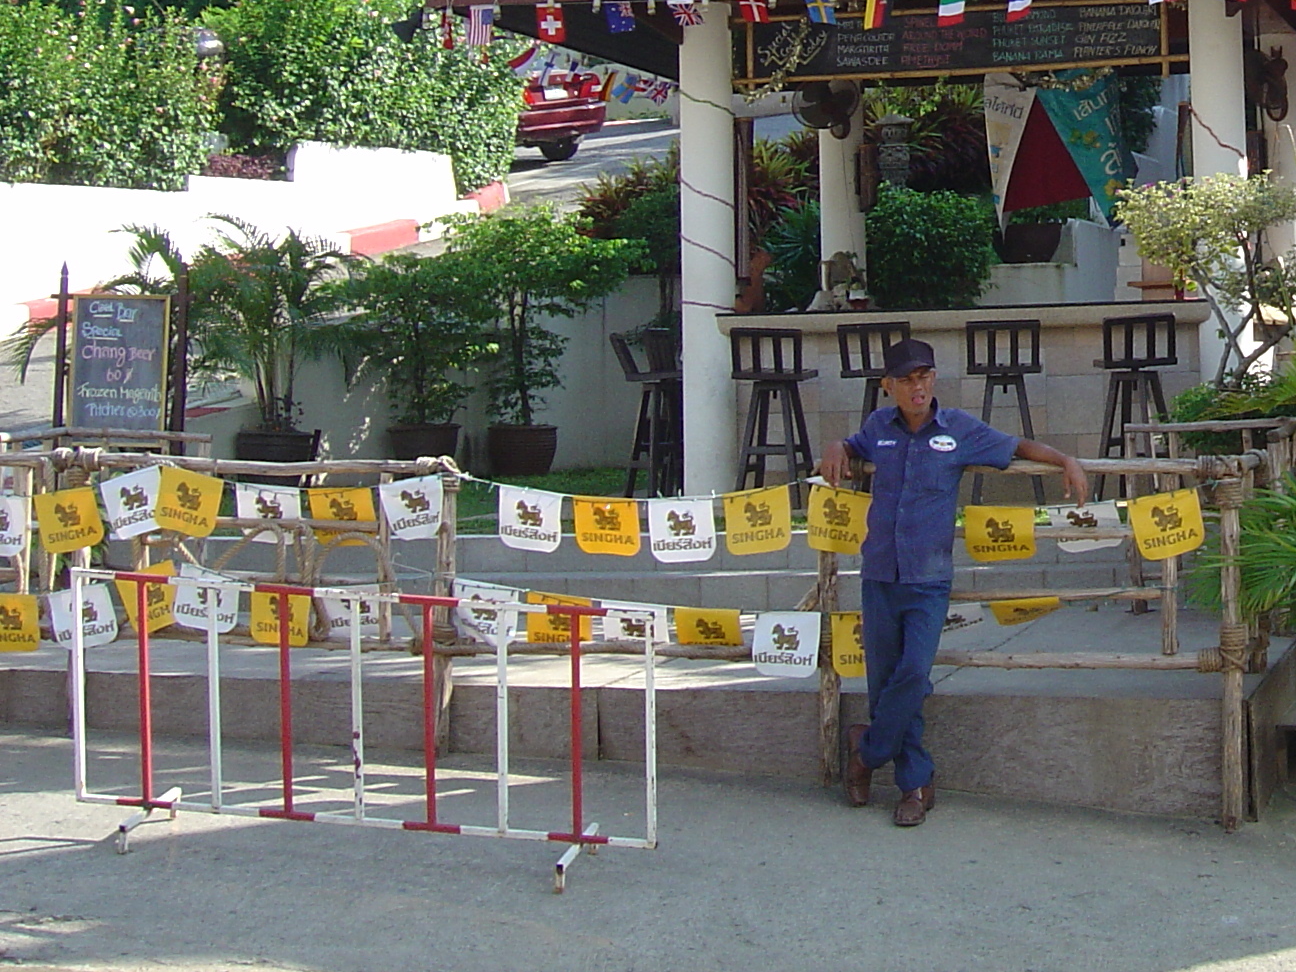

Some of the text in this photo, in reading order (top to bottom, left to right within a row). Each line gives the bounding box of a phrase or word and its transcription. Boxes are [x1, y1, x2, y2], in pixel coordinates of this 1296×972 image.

[82, 339, 126, 368] Chang
[160, 506, 209, 528] SINGHA
[48, 526, 98, 544] SINGHA
[582, 532, 635, 546] SINGHA
[732, 527, 786, 544] SINGHA
[1143, 528, 1199, 550] SINGHA
[972, 544, 1030, 554] SINGHA
